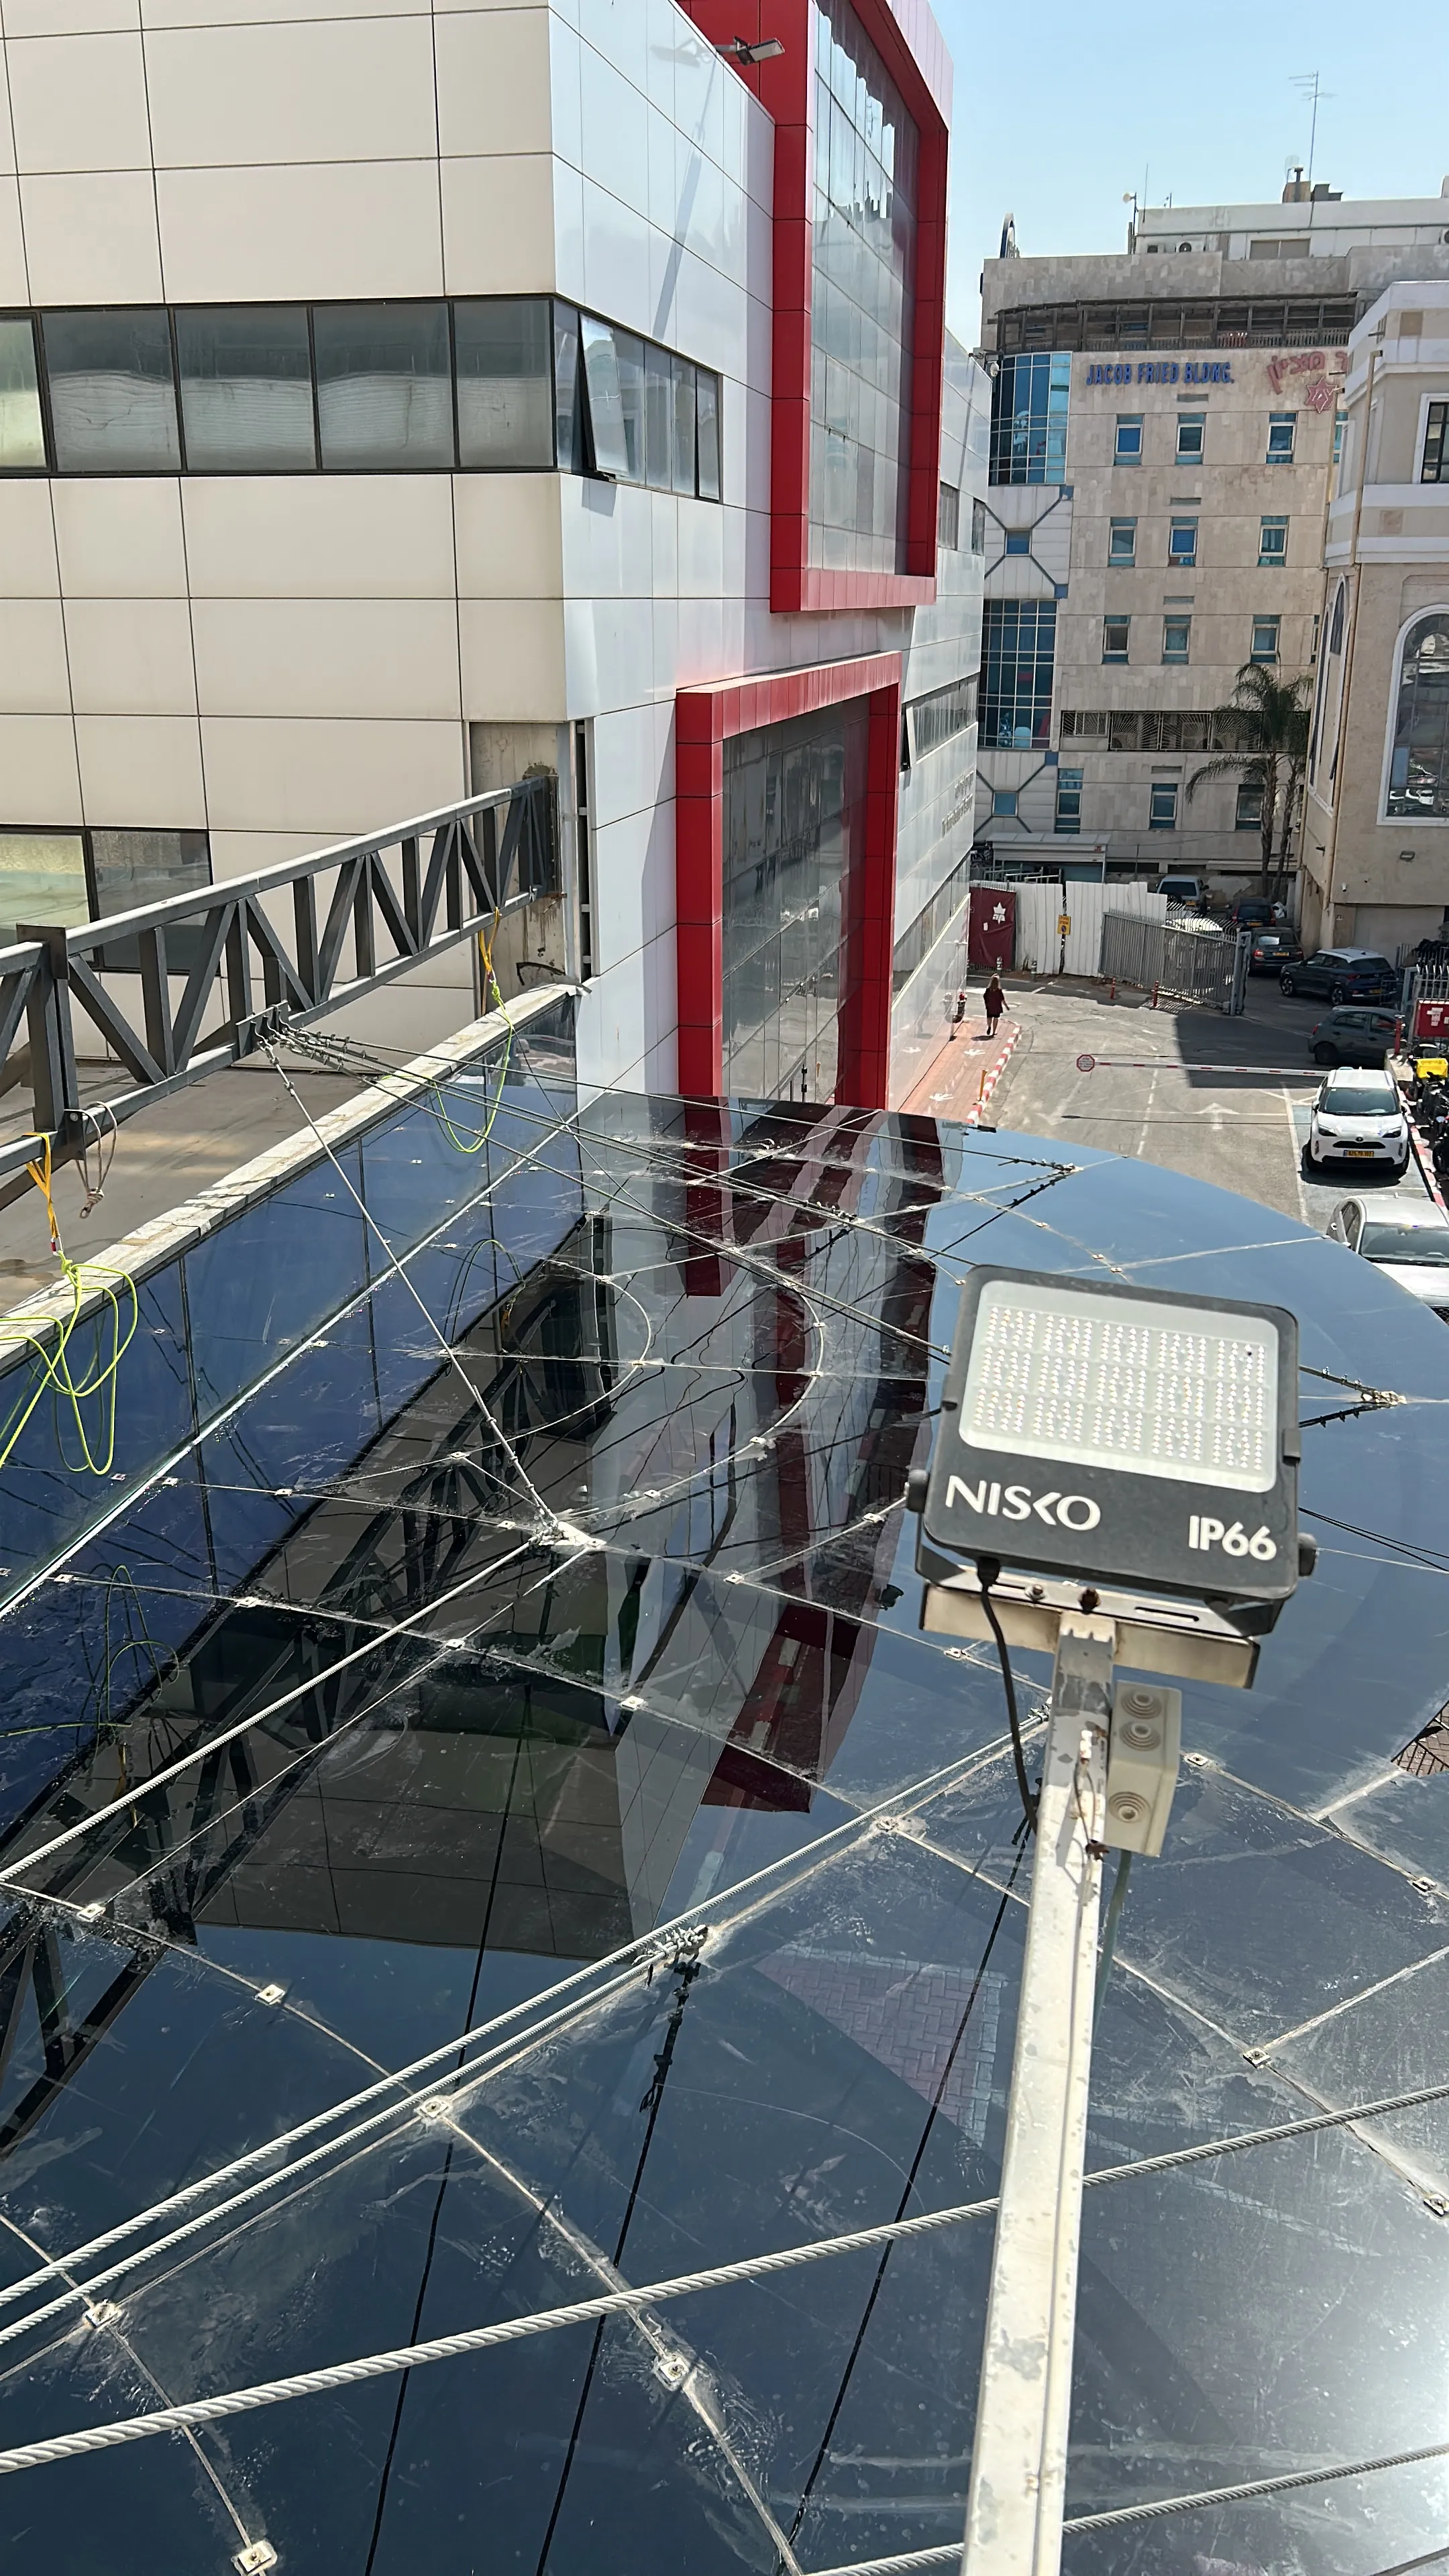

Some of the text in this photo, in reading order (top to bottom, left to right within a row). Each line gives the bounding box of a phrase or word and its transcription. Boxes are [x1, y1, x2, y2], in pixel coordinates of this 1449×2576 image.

[1087, 362, 1235, 385] JACOB FRIED BLDNG.
[945, 1475, 1101, 1531] NISKO
[1189, 1515, 1277, 1561] IP66
